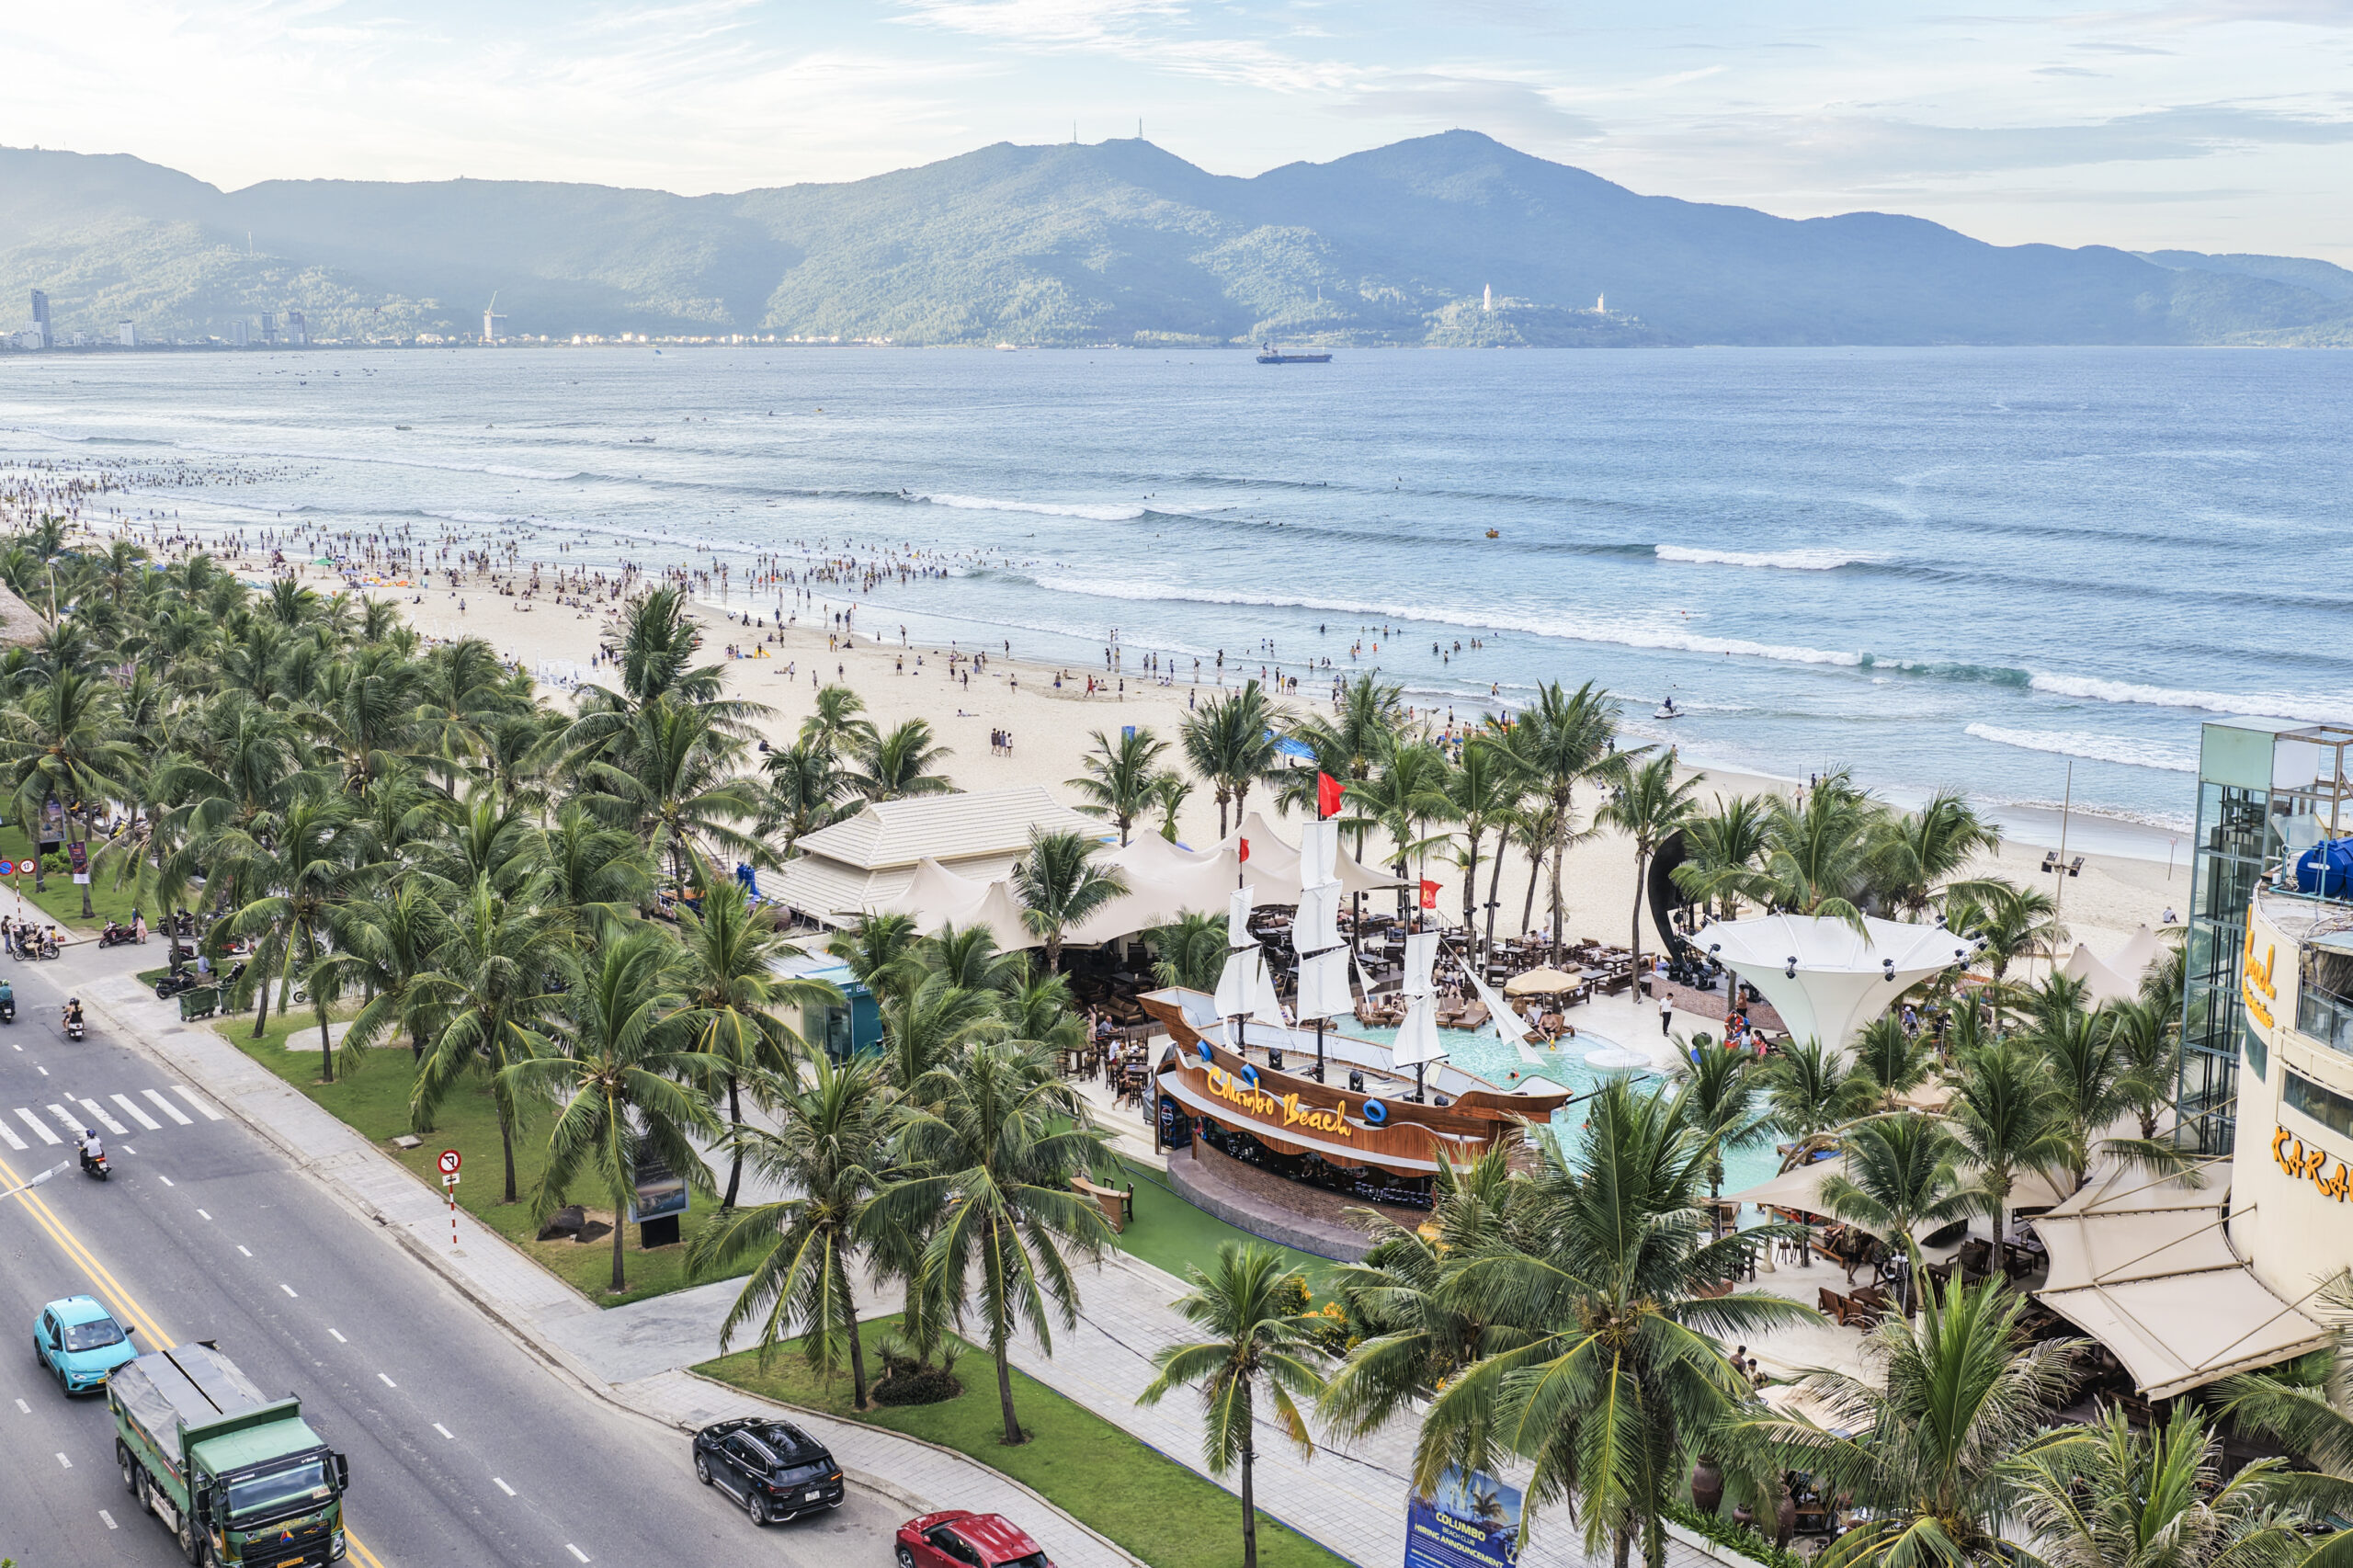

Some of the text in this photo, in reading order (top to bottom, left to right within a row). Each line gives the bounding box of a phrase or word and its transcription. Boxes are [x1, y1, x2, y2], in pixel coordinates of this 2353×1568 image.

[1207, 1066, 1352, 1137] Columbo Beach
[2271, 1126, 2353, 1202] KARA
[1415, 1523, 1440, 1540] HIRING
[1440, 1534, 1505, 1568] ANNOUNCEMENT
[1436, 1512, 1485, 1542] COLUMBO
[1442, 1527, 1476, 1547] BEACH CLUB
